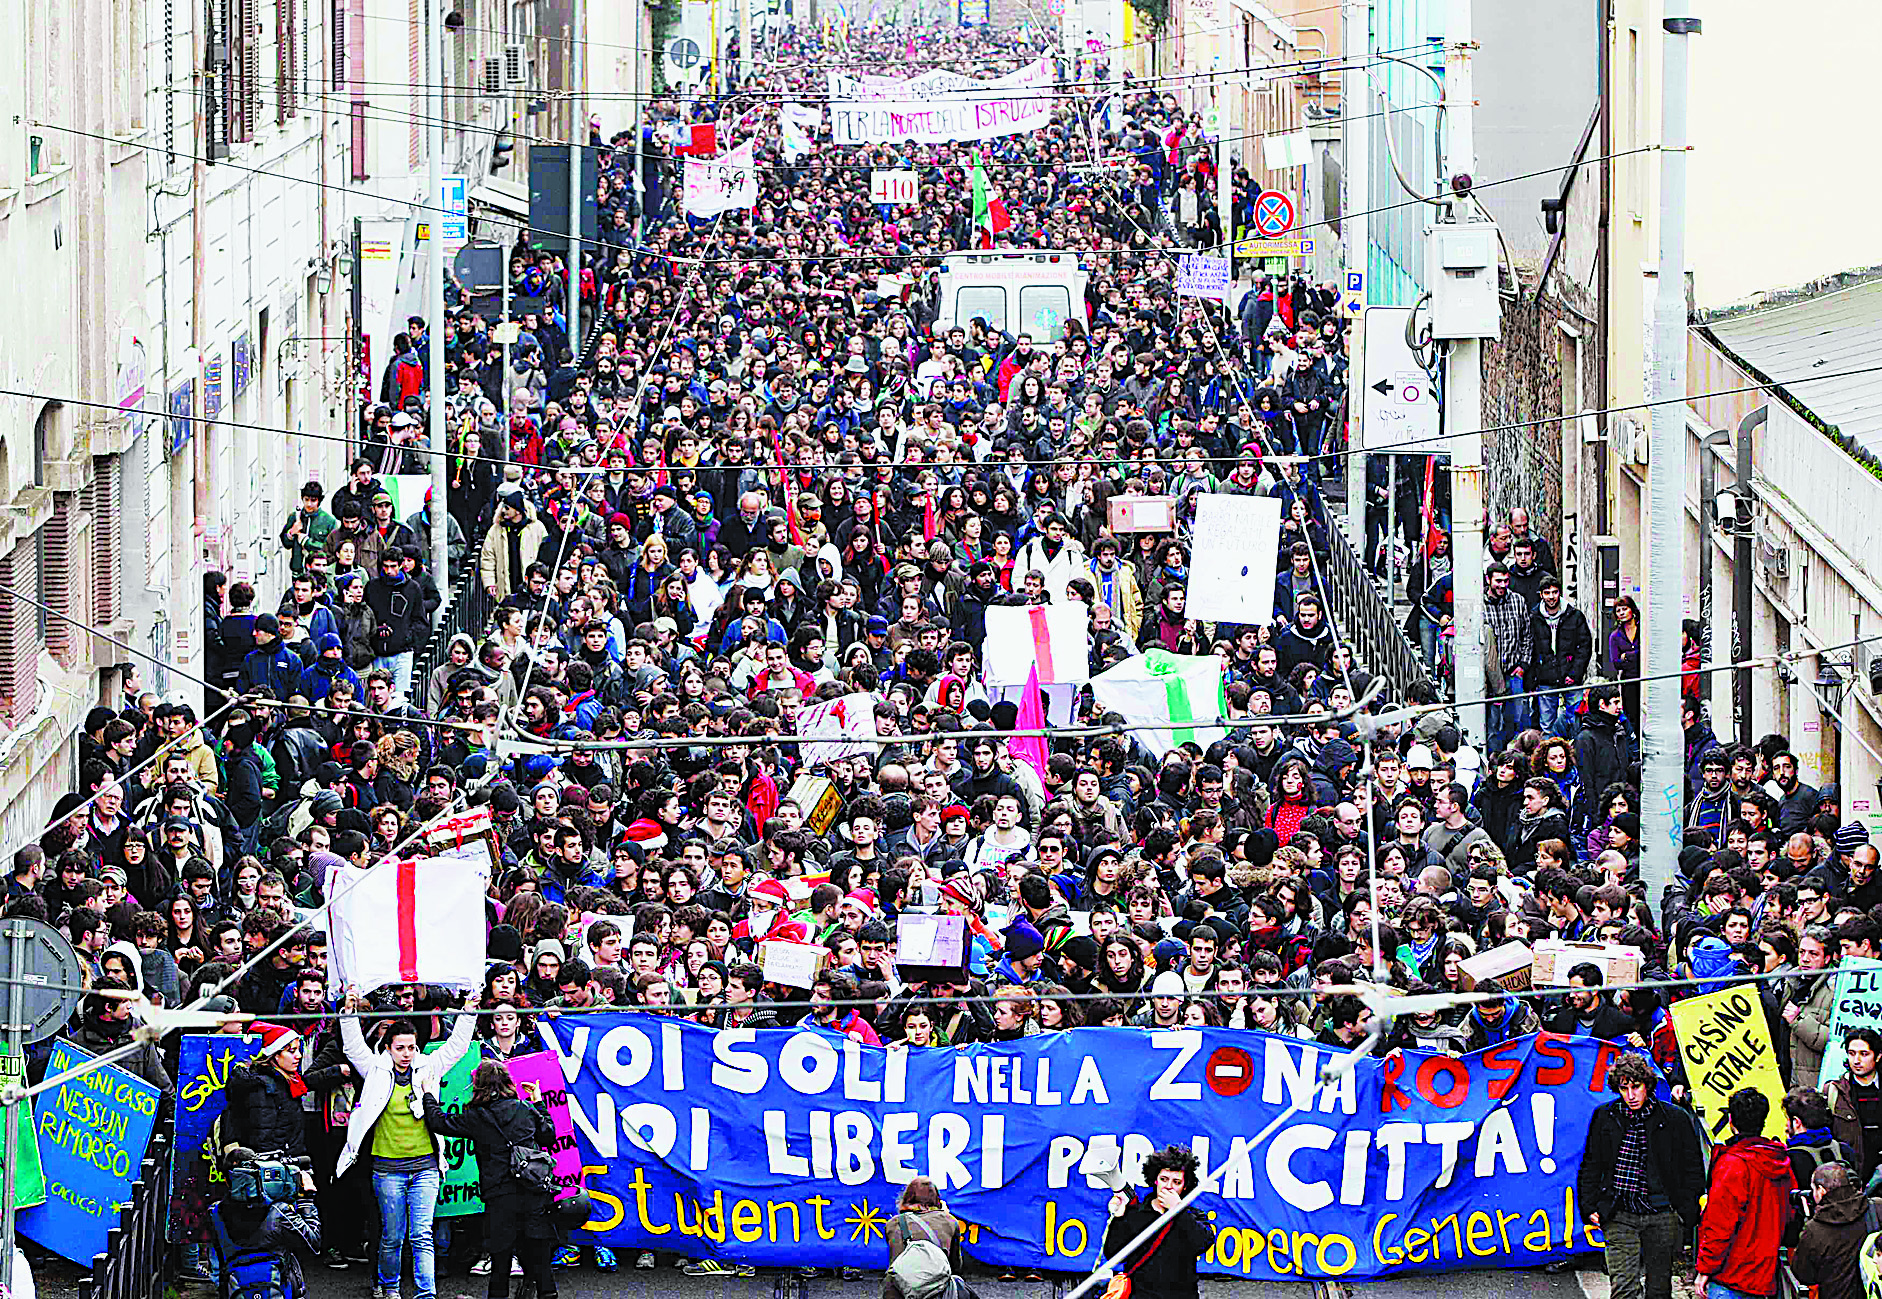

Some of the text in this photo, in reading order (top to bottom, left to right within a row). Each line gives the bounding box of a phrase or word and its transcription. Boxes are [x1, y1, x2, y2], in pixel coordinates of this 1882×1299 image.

[837, 110, 869, 140] PER
[873, 110, 890, 136] LA
[890, 111, 938, 137] MORTE
[876, 179, 913, 200] 410
[1249, 240, 1312, 252] AUTORIMESSA P
[954, 271, 1067, 280] CENTRO MOBILE RIANIMAZIONE
[1350, 274, 1360, 289] P
[1846, 971, 1879, 994] Il
[1685, 993, 1752, 1065] CASINO
[53, 1048, 72, 1075] IN
[114, 1083, 156, 1116] CASO
[180, 1047, 242, 1112] Salt
[535, 1020, 685, 1091] VOI
[711, 1026, 909, 1102] SOLI
[952, 1055, 1110, 1106] NELLA
[1149, 1029, 1357, 1115] ZONA
[1701, 1029, 1766, 1097] TOTALE
[55, 1083, 129, 1141] NESSUN
[541, 1089, 568, 1108] TRO
[39, 1110, 130, 1177] RIMORSO
[567, 1092, 711, 1171] NOI
[763, 1110, 1005, 1190] LIBERI
[1191, 1135, 1255, 1199] LA
[1044, 1201, 1088, 1258] lo
